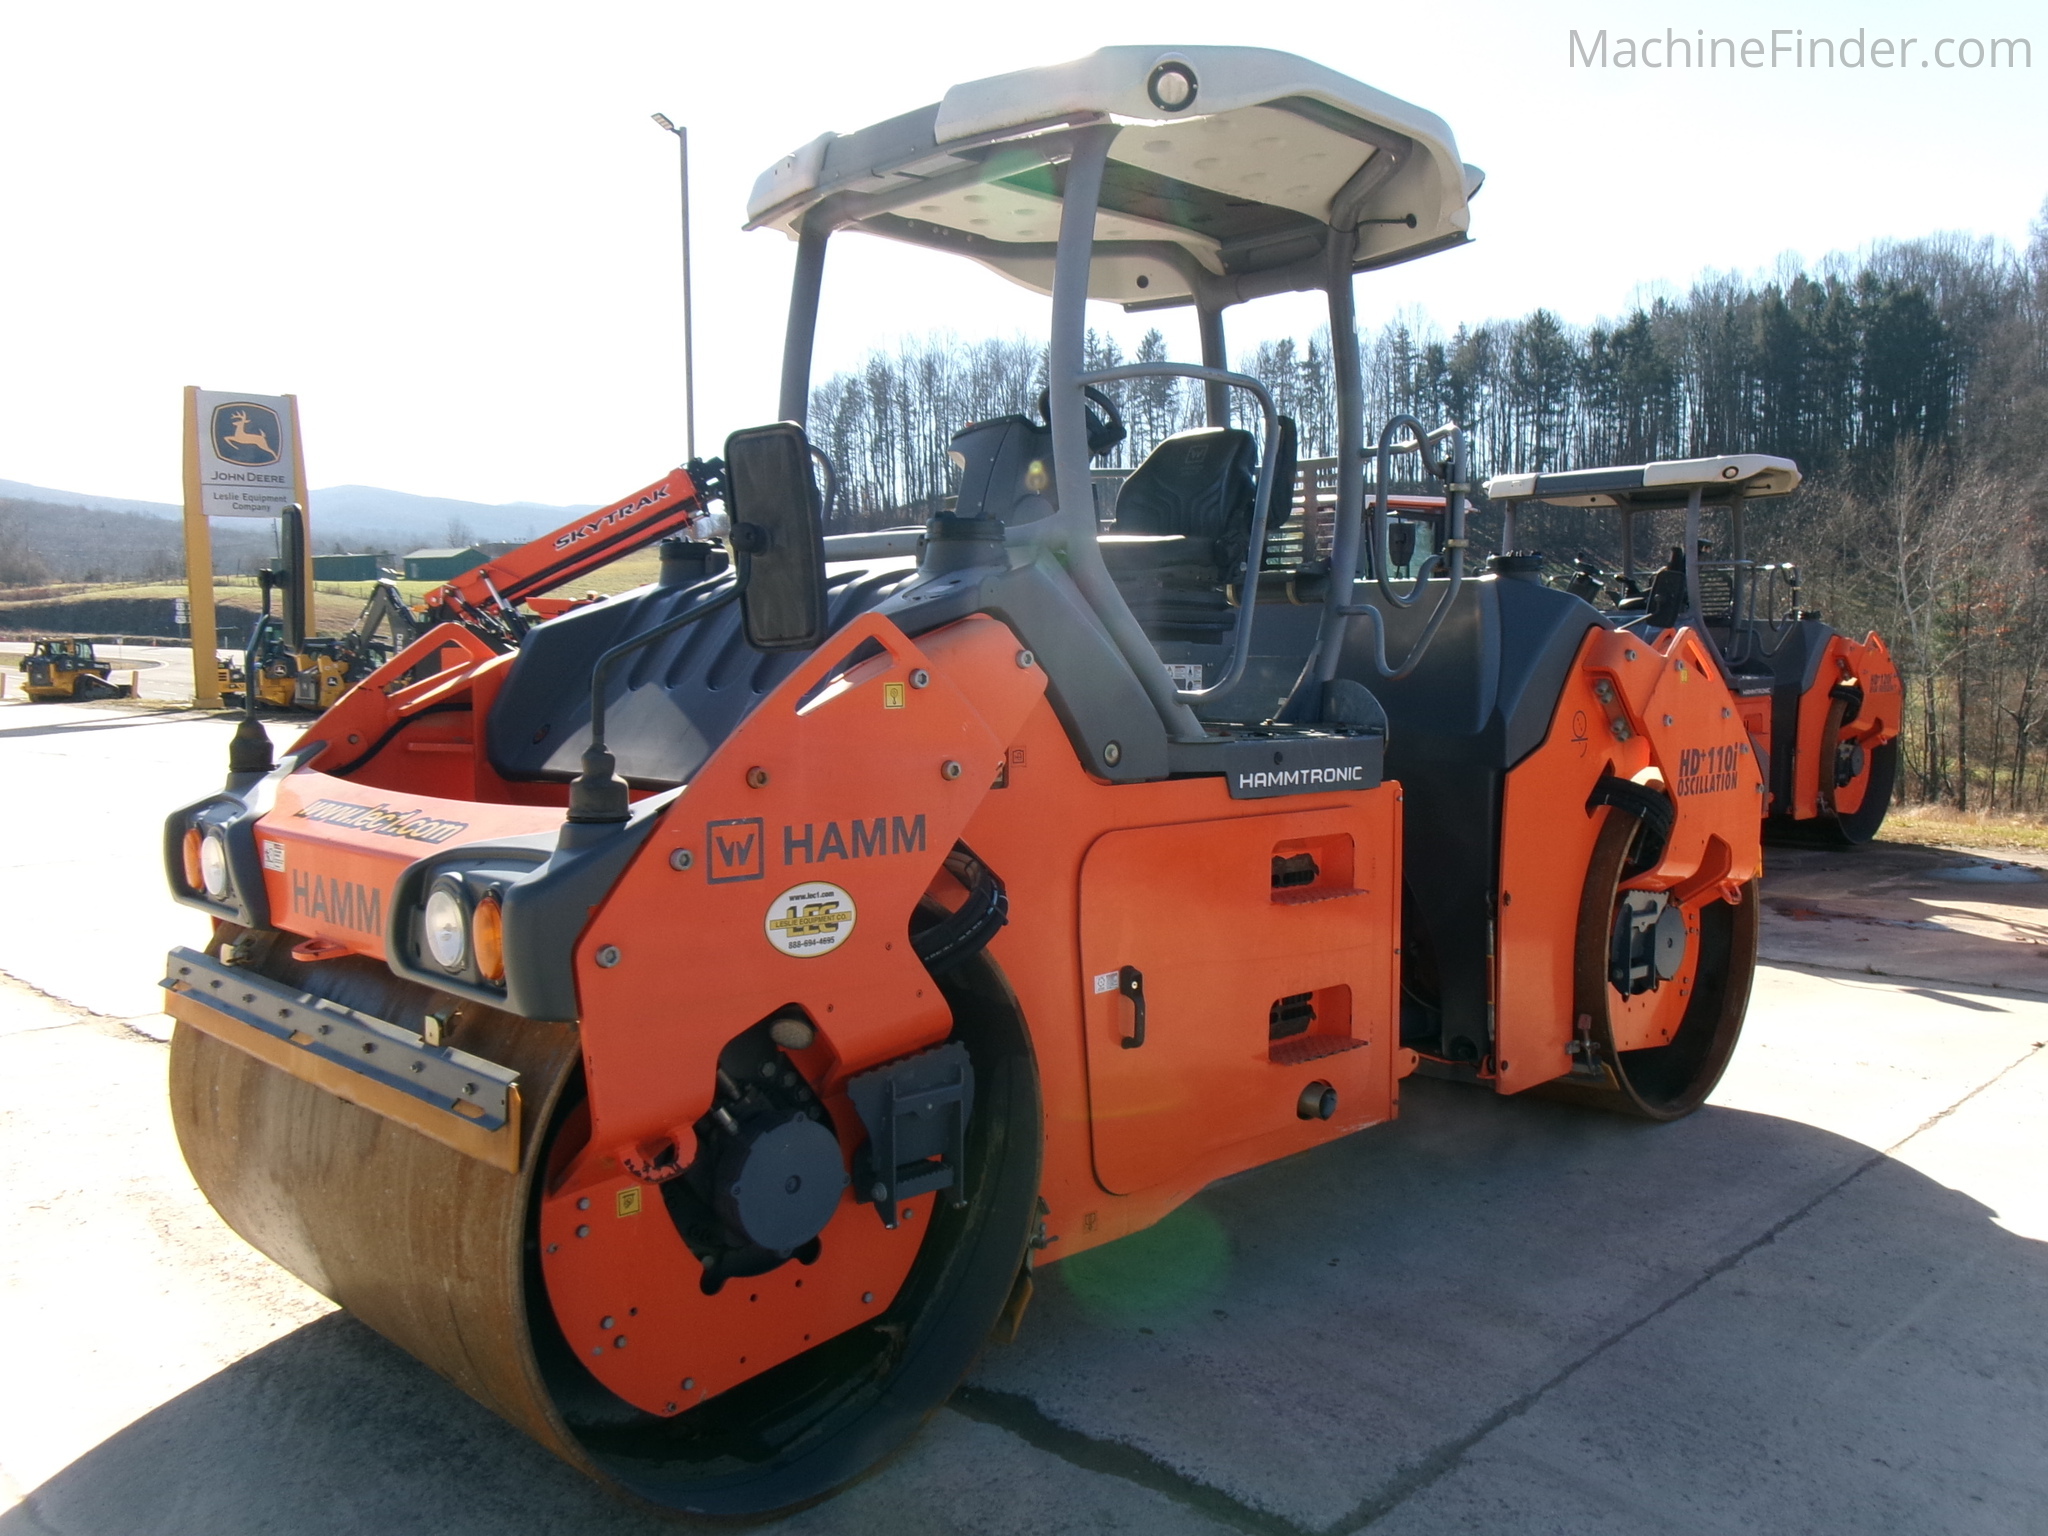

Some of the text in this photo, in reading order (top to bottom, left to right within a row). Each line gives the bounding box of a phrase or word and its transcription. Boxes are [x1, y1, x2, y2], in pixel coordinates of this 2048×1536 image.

[211, 471, 286, 483] JOHN DEERE
[213, 492, 288, 502] Leslie Equipment
[232, 502, 271, 512] Company
[554, 484, 670, 551] SKYTRAK
[1239, 766, 1363, 789] HAMMTRONIC
[1677, 771, 1738, 797] OSCILLATION
[297, 800, 467, 843] www.lec1.com
[783, 814, 926, 866] HAMM
[293, 868, 381, 937] HAMM
[789, 891, 835, 901] www.lec1.com
[775, 919, 798, 928] LESLIE
[800, 915, 836, 925] EQUIPMENT
[788, 936, 835, 949] 888-694-4695
